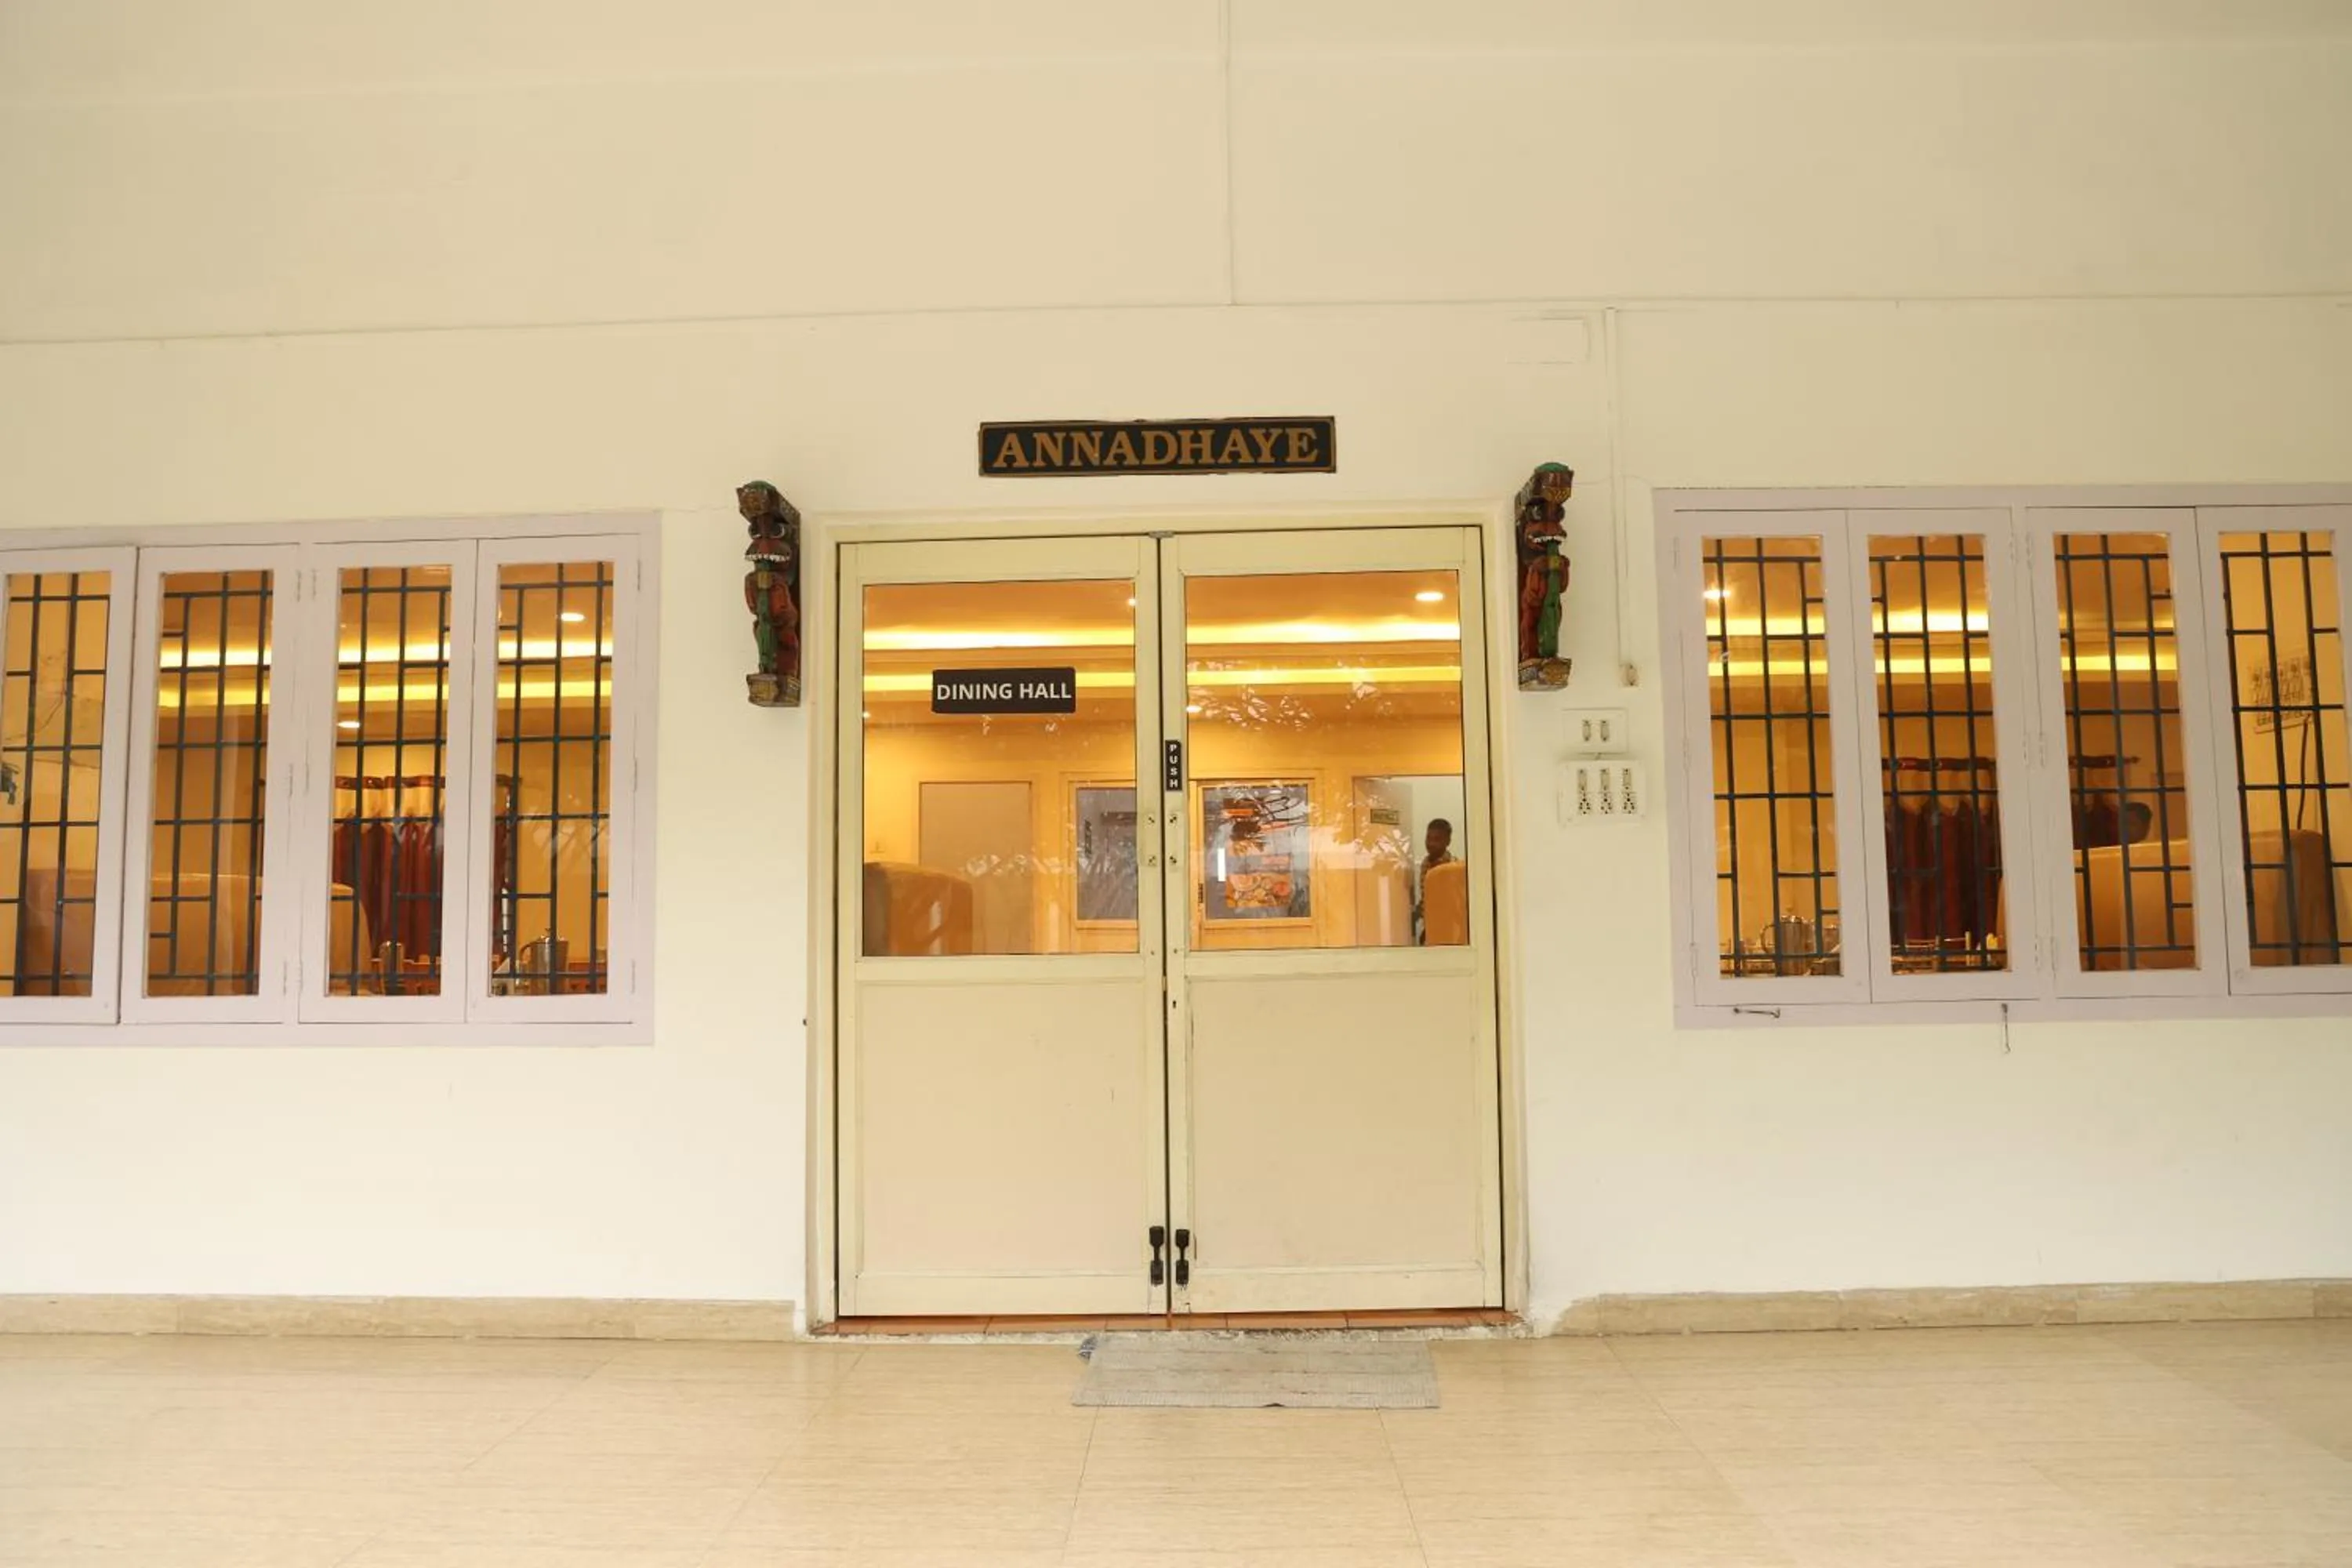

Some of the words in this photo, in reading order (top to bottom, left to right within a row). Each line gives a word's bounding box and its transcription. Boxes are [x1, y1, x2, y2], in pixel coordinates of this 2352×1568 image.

[993, 428, 1318, 467] ANNADHAYE
[937, 684, 1013, 700] DINING
[1019, 682, 1073, 699] HALL
[1168, 743, 1179, 789] PUSH
